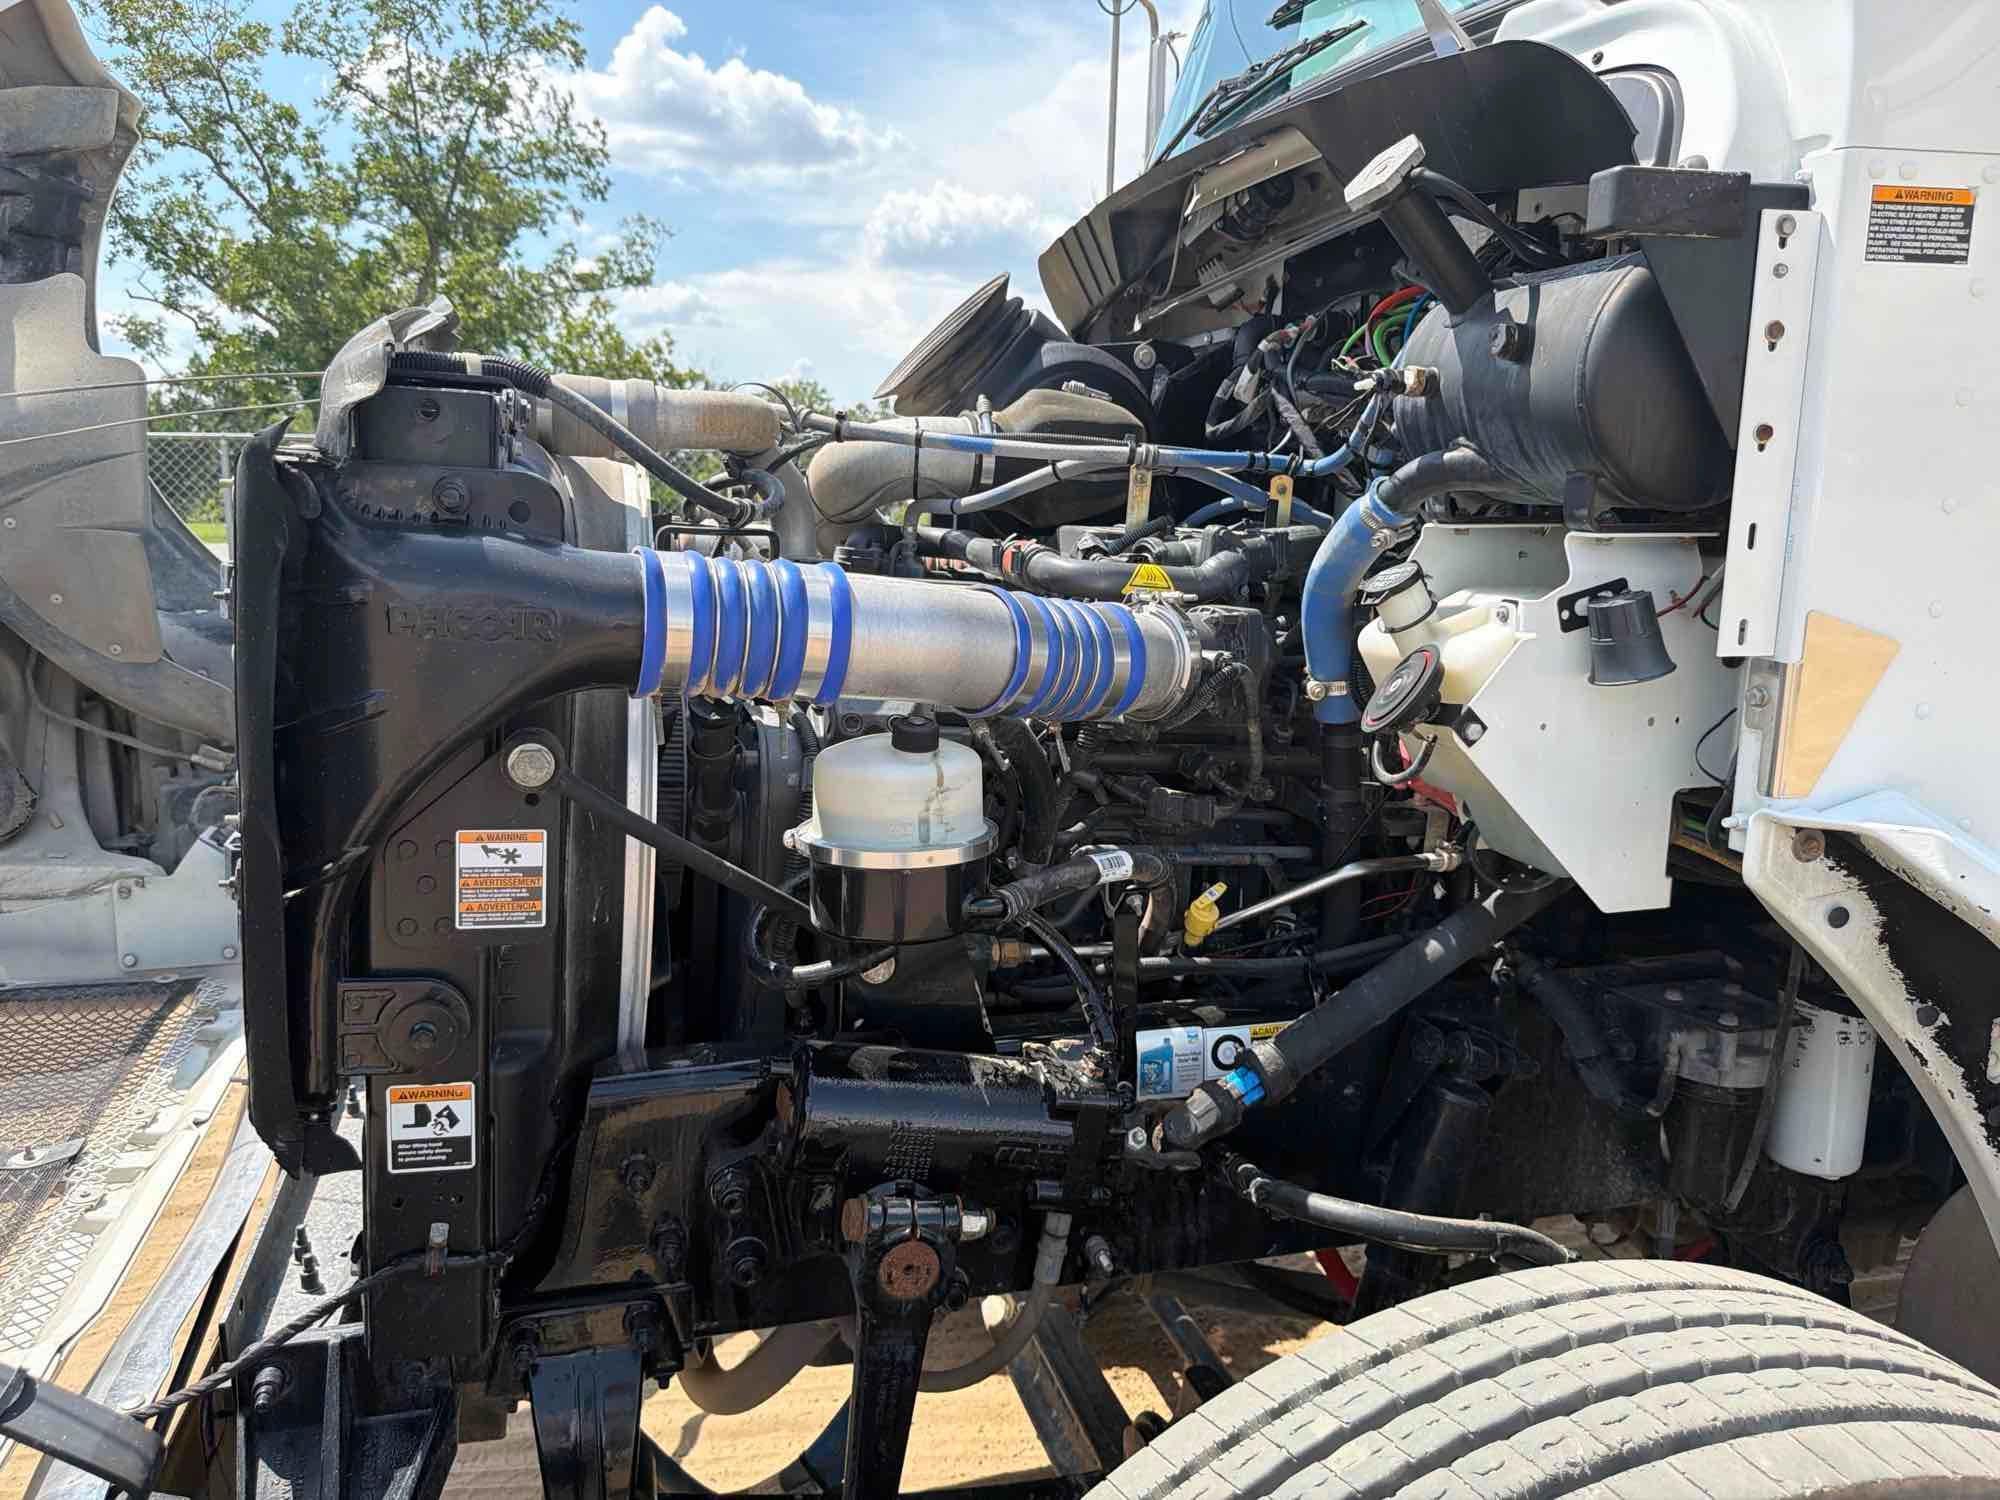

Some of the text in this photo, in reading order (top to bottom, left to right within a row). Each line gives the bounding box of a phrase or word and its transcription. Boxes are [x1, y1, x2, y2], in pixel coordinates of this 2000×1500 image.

[1904, 190, 1954, 202] WARNING
[486, 832, 528, 842] WARNING
[473, 878, 540, 888] AVERTISSEMENT
[478, 902, 537, 911] ADVERTENCIA
[408, 1089, 464, 1099] WARNING
